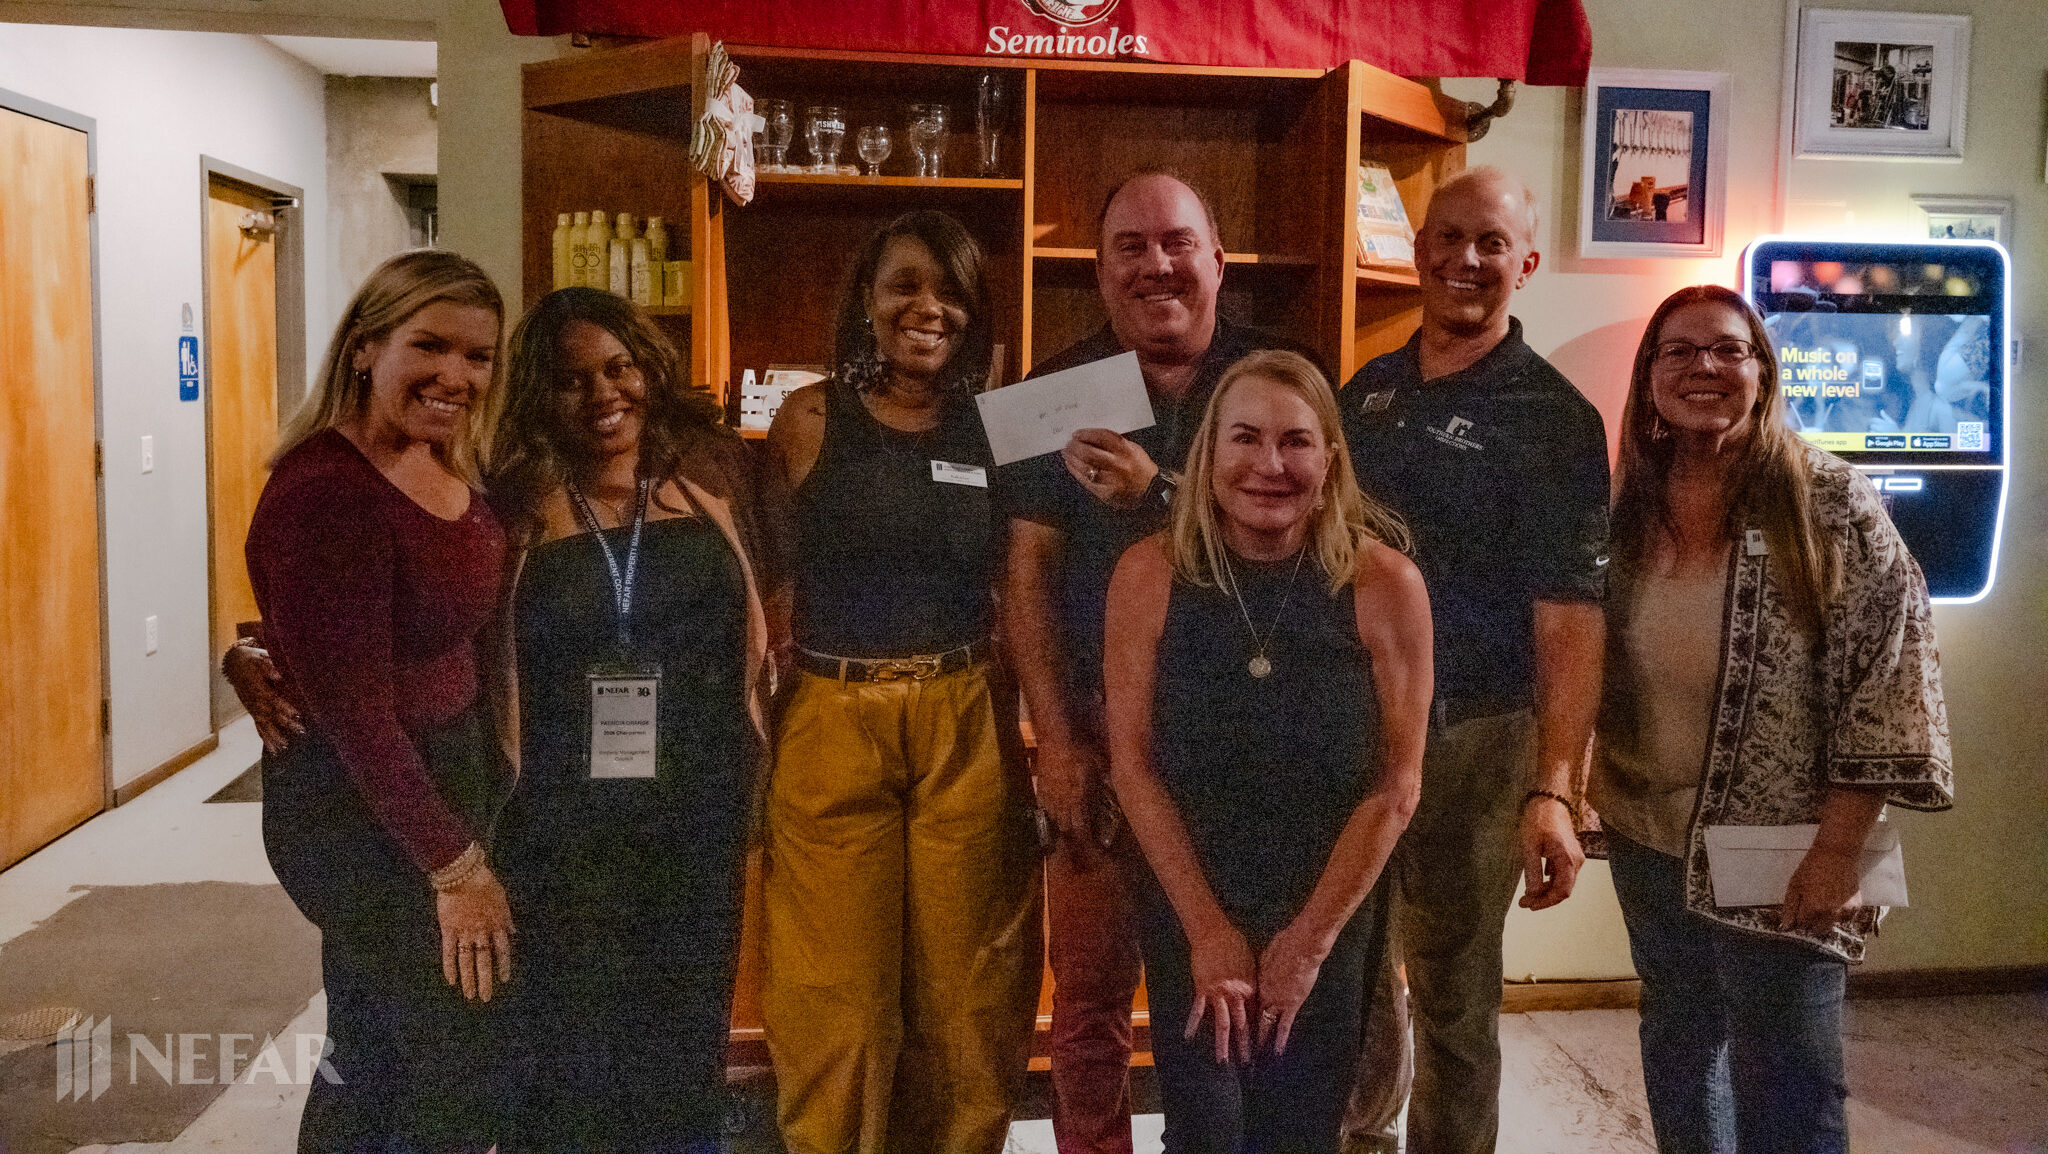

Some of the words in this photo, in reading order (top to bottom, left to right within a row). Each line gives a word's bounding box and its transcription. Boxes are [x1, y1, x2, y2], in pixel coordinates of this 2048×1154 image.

[985, 26, 1148, 56] Seminoles
[1781, 347, 1832, 363] Music
[1835, 350, 1857, 363] on
[1781, 369, 1793, 381] a
[1797, 365, 1848, 381] whole
[1781, 385, 1818, 398] new
[1822, 382, 1860, 398] level
[580, 500, 599, 534] PROPERTY
[596, 532, 620, 578] MANAGEMENT
[625, 549, 638, 586] PROPERTY
[622, 586, 632, 614] NEFAR
